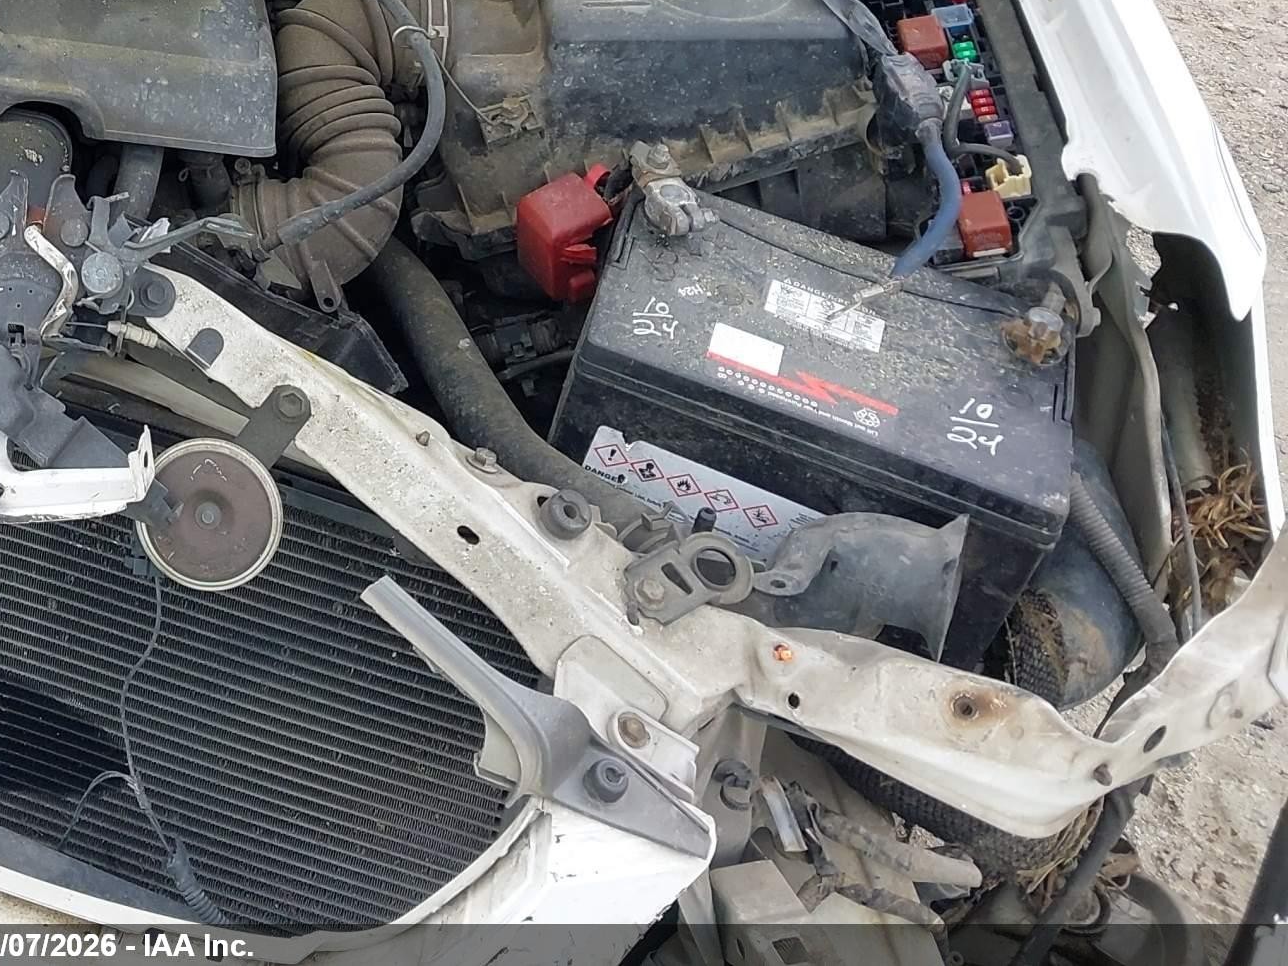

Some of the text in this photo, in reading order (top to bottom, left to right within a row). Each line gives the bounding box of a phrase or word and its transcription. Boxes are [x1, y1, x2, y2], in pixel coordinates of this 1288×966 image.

[643, 296, 670, 315] 10
[632, 319, 679, 339] 24
[958, 397, 993, 419] 10
[947, 425, 1004, 456] 24
